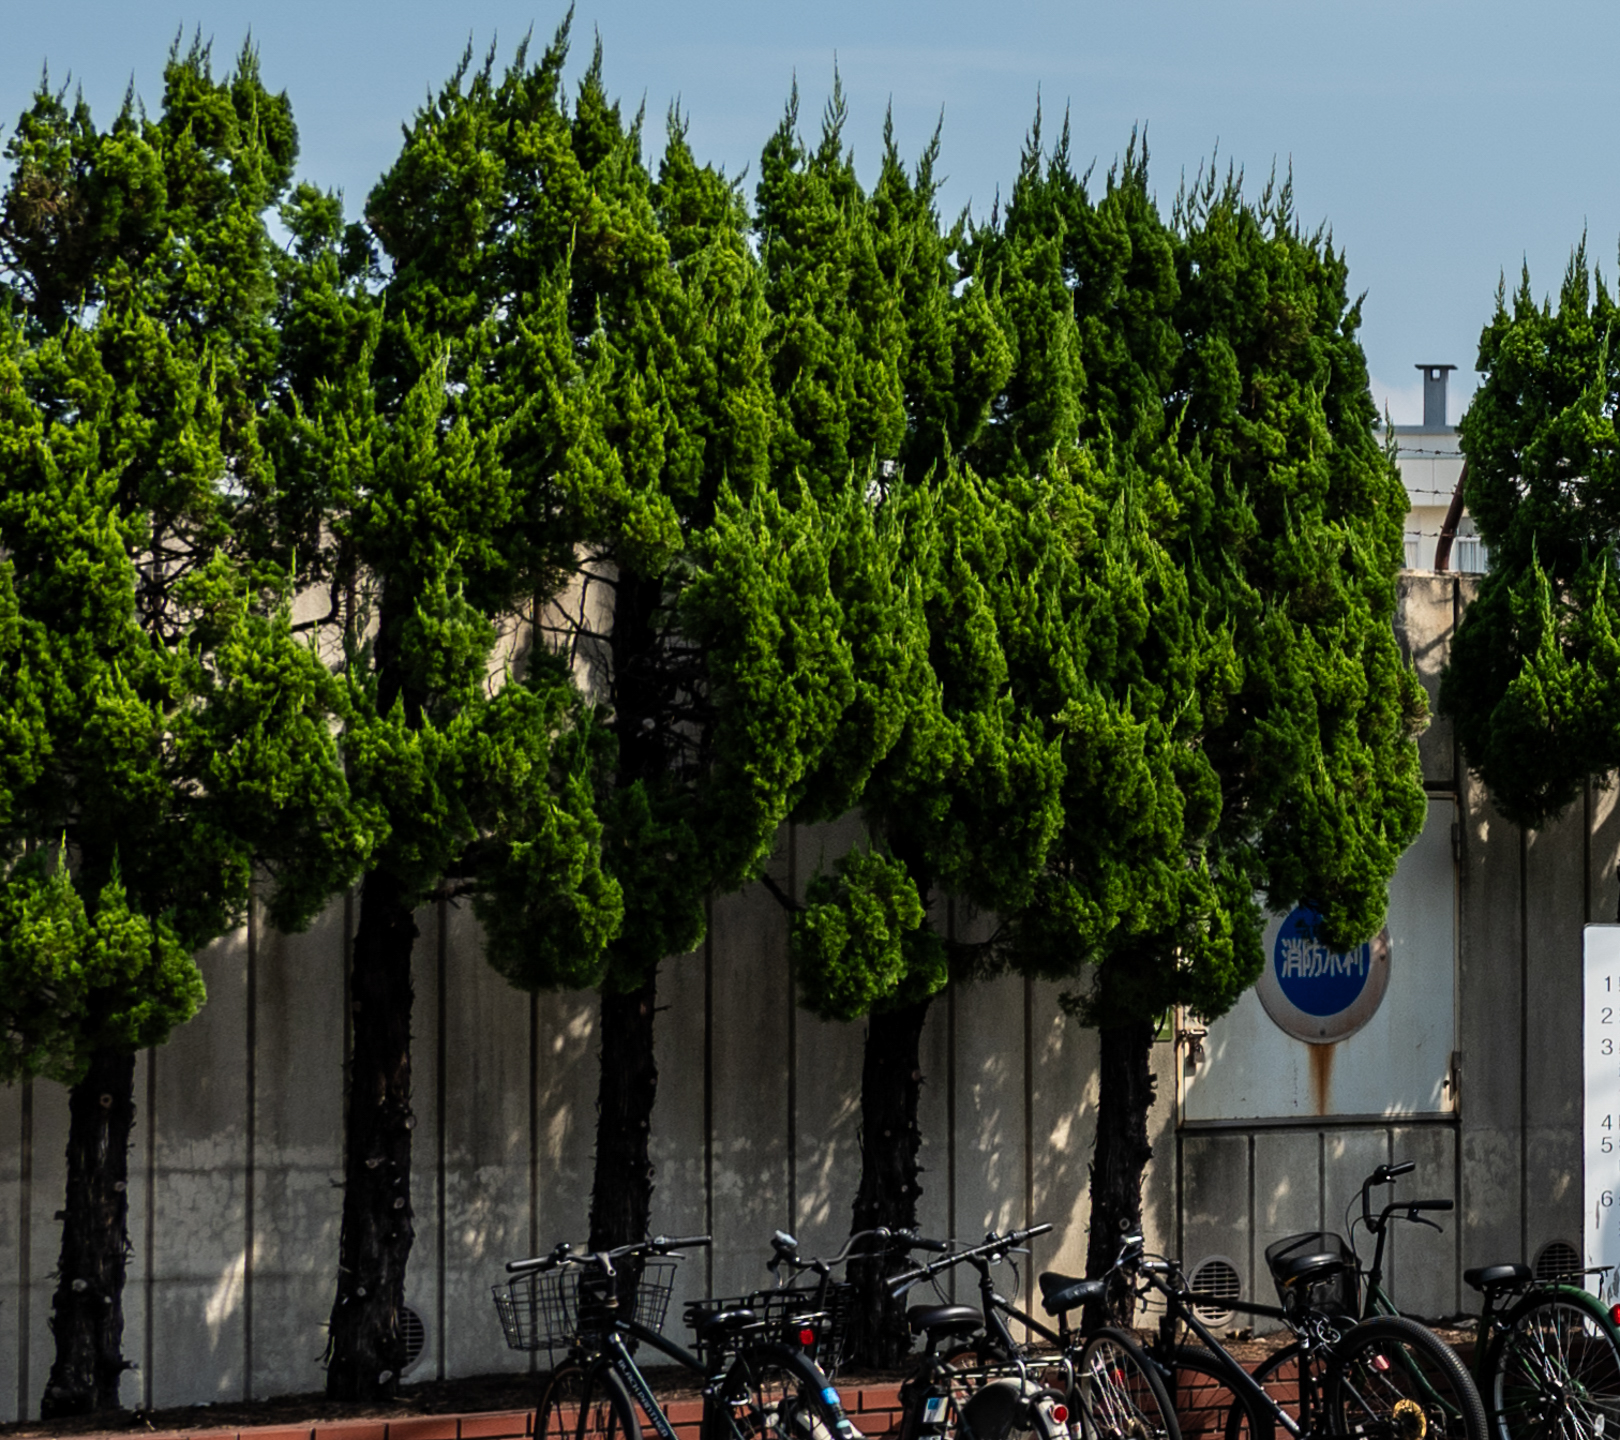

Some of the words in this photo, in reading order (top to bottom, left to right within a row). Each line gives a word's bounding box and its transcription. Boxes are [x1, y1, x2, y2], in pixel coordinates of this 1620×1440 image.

[1281, 937, 1364, 978] 消防水利
[1604, 975, 1611, 992] 1
[1601, 1007, 1613, 1024] 2
[1601, 1038, 1614, 1055] 3
[1601, 1114, 1613, 1130] 4
[1601, 1137, 1613, 1153] 5
[1601, 1190, 1614, 1207] 6
